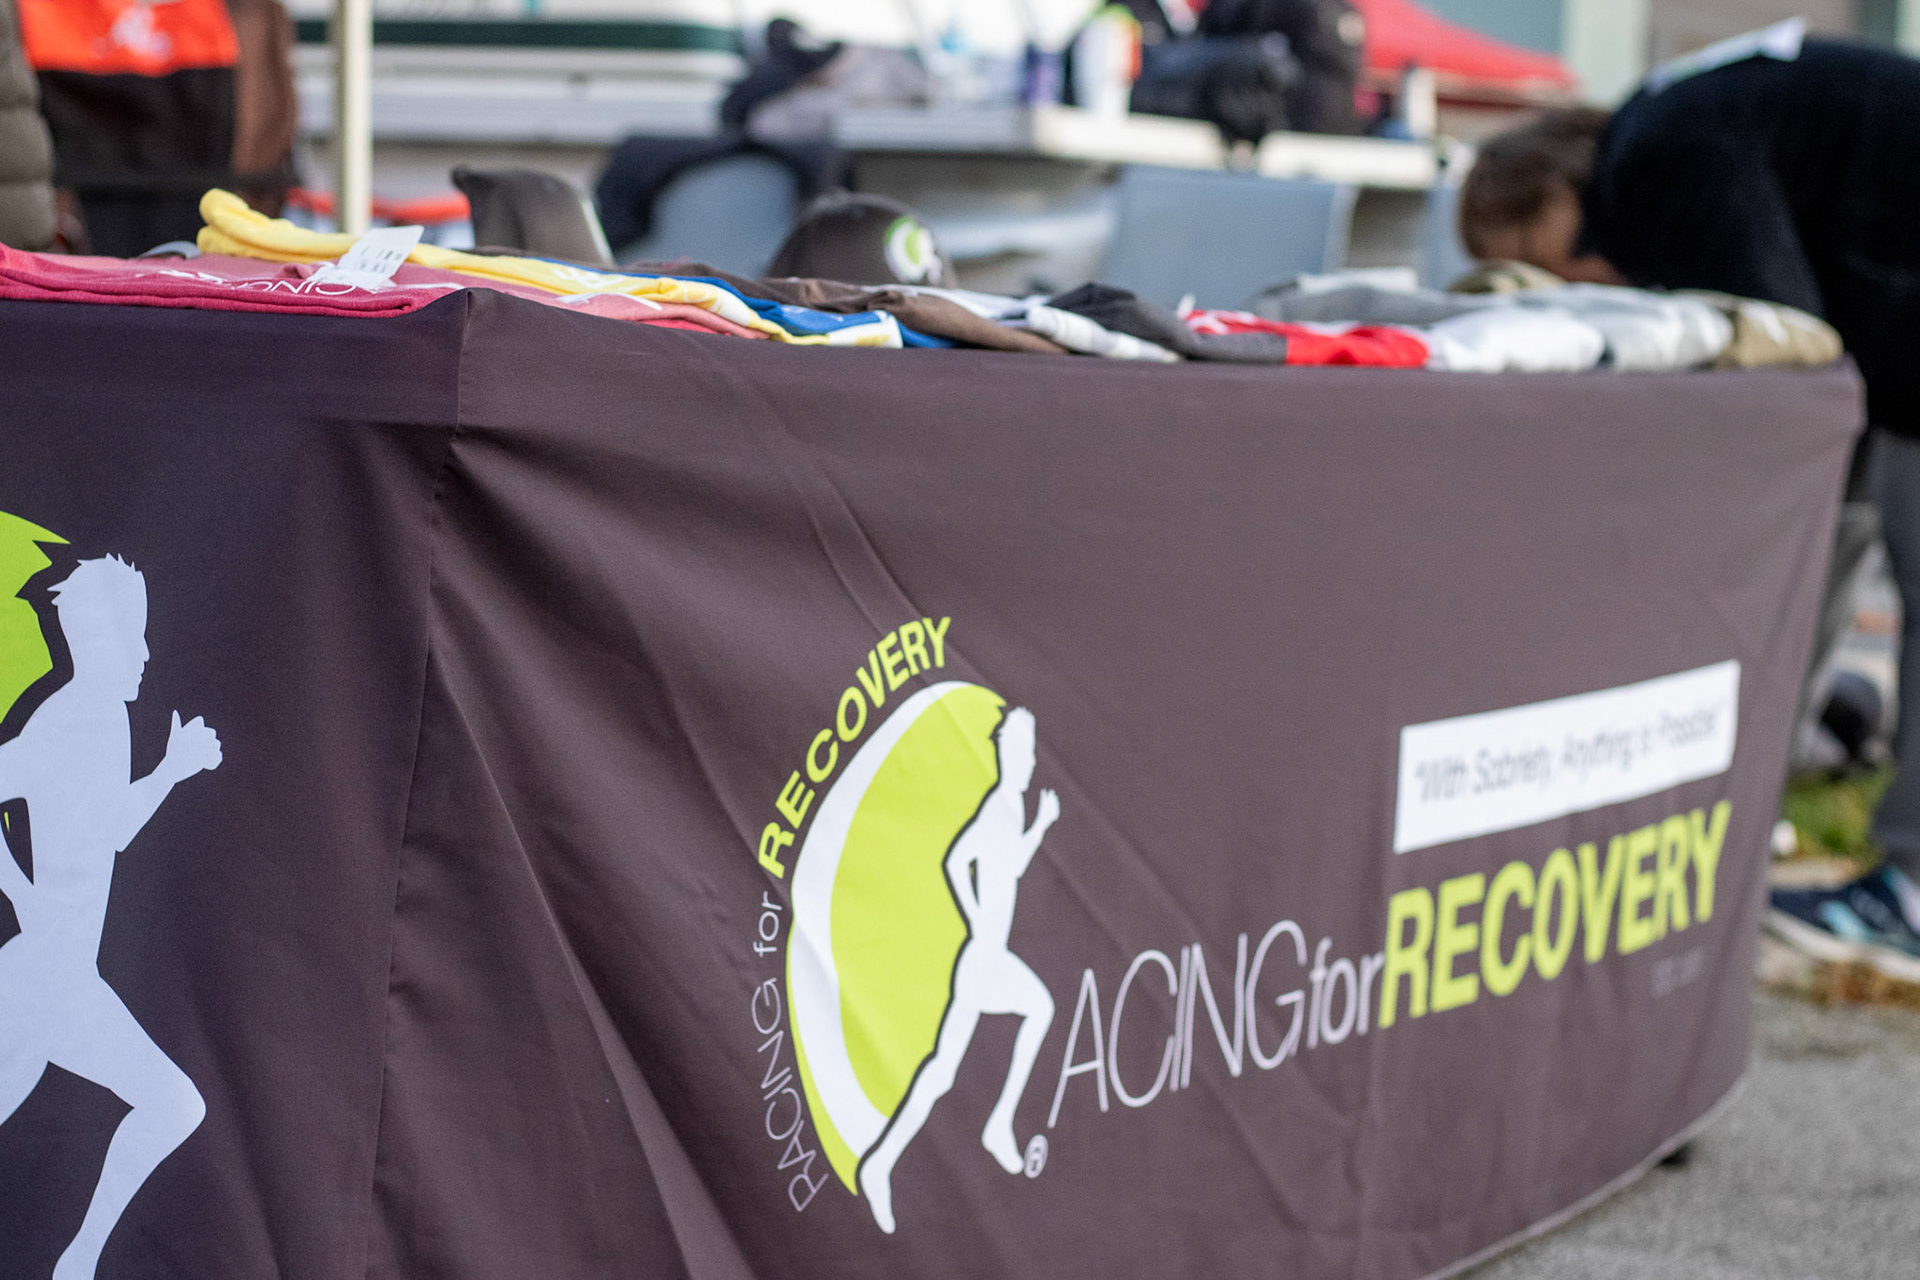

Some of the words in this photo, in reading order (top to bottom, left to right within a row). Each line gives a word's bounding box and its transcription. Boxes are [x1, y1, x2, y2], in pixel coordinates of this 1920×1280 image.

[758, 615, 952, 879] RECOVERY
[753, 890, 783, 958] for
[1378, 801, 1730, 1029] RECOVERY
[751, 977, 830, 1213] RACING
